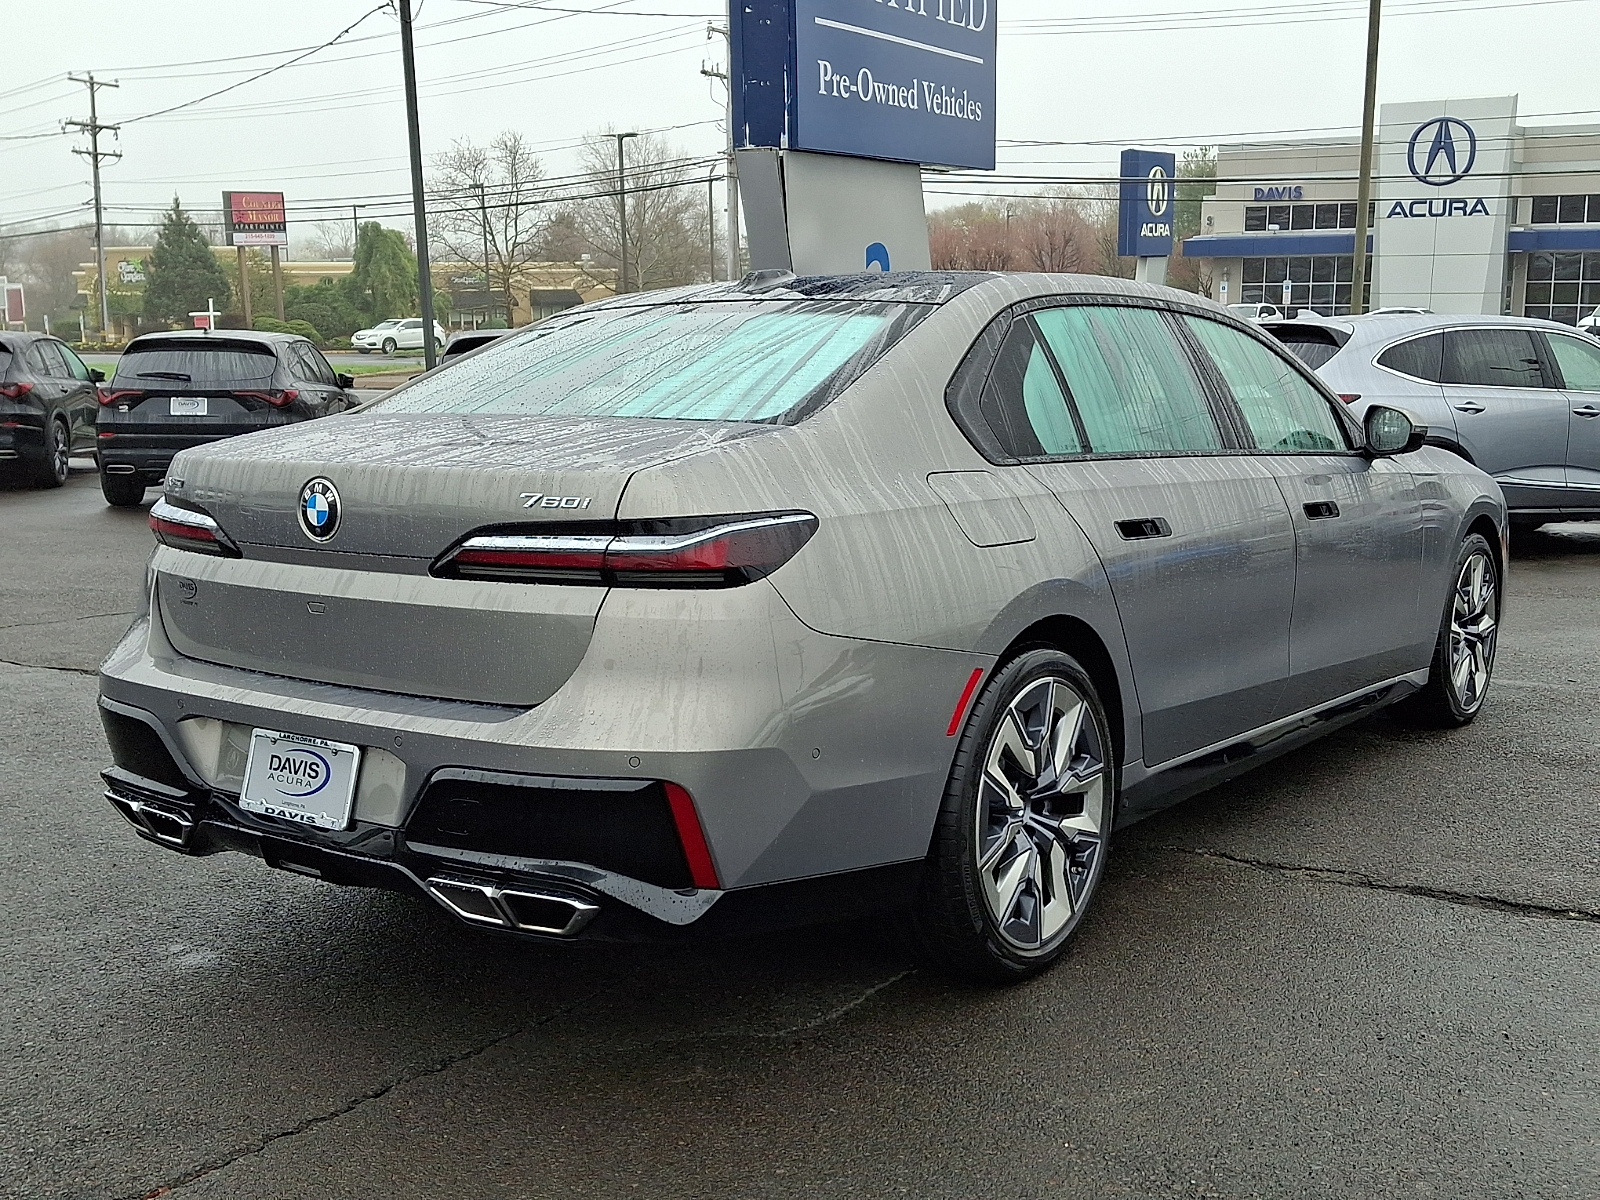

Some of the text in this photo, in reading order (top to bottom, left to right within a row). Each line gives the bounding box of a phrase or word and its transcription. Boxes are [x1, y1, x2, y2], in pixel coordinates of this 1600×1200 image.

[817, 59, 981, 121] Pre-Owned Vehicles
[1254, 186, 1303, 201] DAVIS
[1386, 198, 1490, 219] ACURA
[1140, 223, 1171, 237] ACURA
[305, 483, 335, 502] BMW
[519, 492, 592, 509] 760i
[269, 754, 320, 779] DAVIS
[267, 773, 312, 788] ACURA
[264, 807, 317, 823] DAVIS
